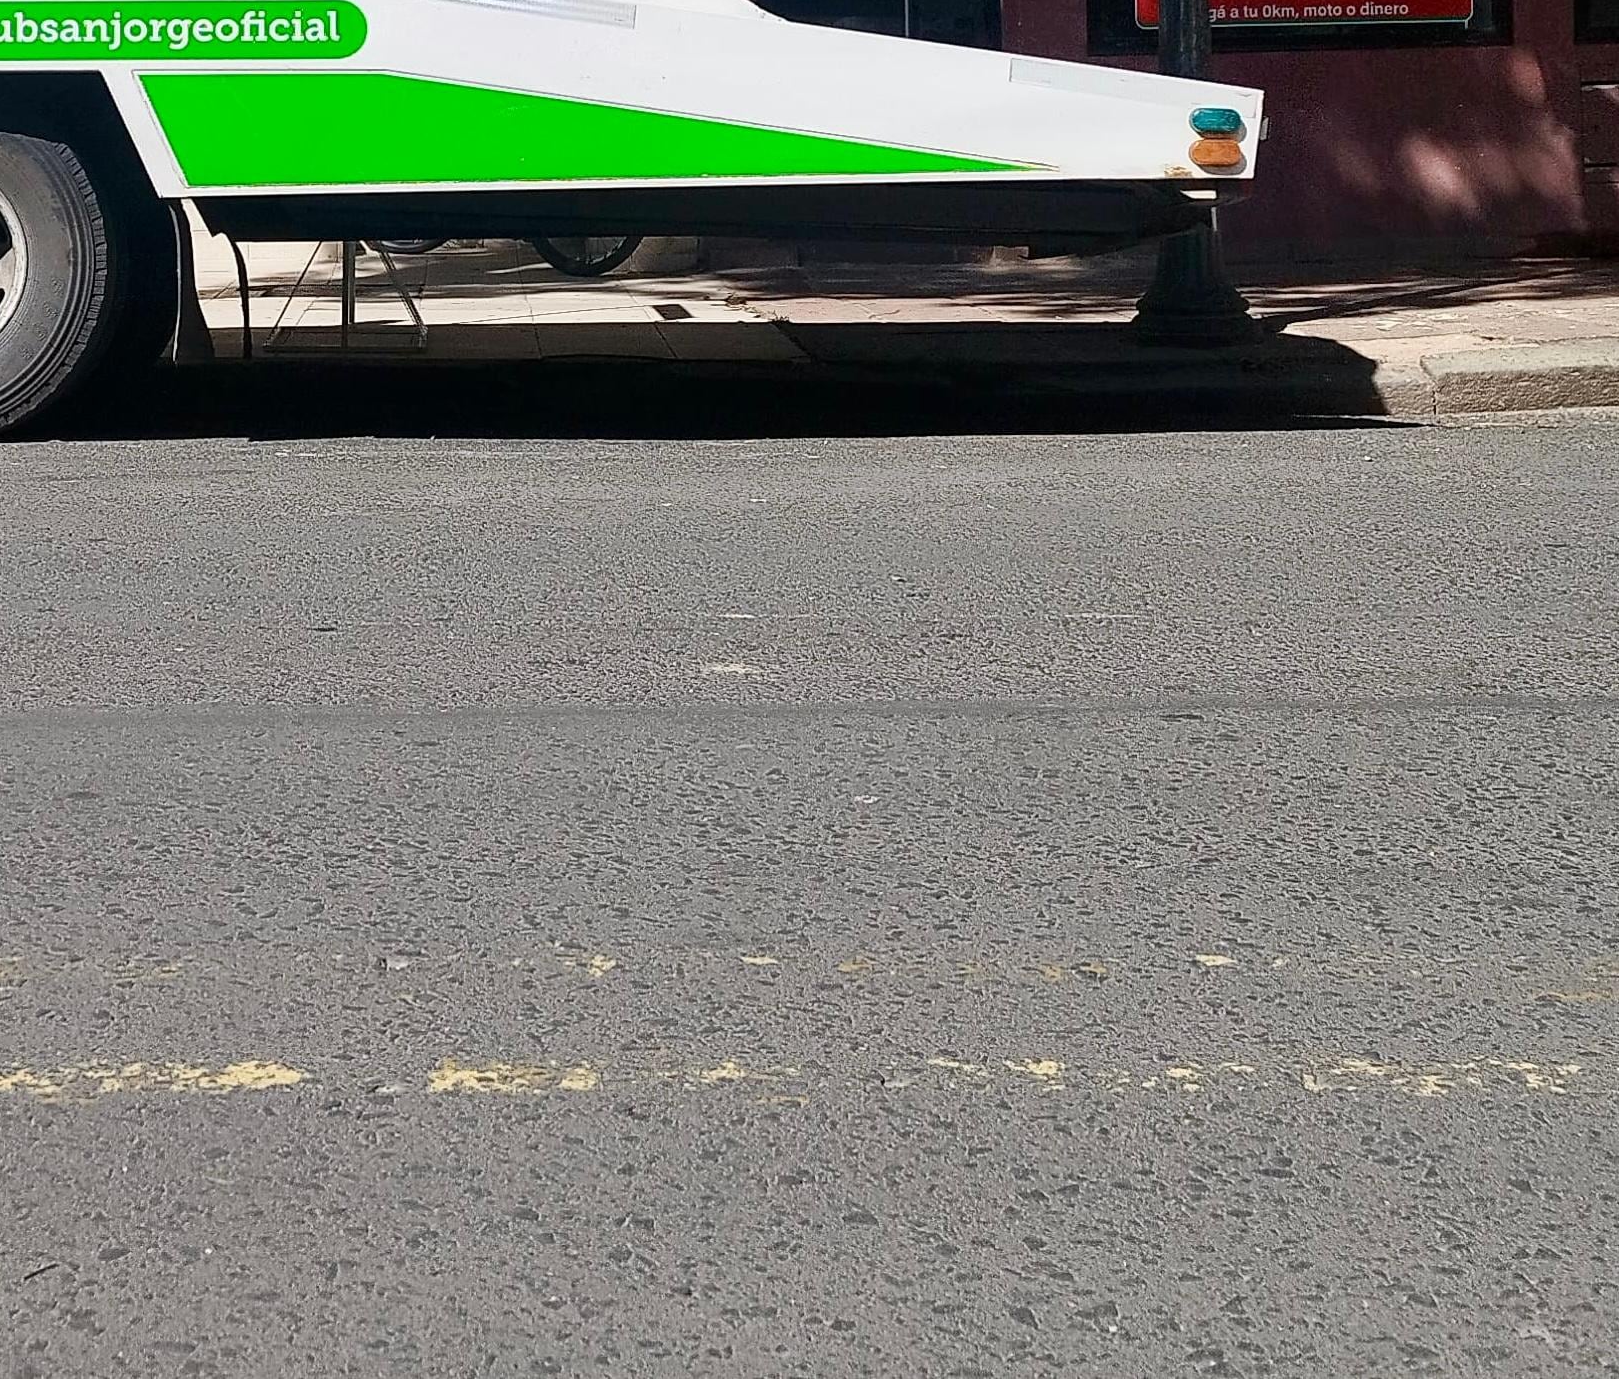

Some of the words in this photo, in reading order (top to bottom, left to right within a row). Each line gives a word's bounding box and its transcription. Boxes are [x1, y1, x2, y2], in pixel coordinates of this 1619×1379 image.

[1230, 8, 1239, 18] a
[1243, 5, 1258, 18] tu
[1262, 5, 1299, 19] 0km,
[1303, 3, 1341, 17] moto
[1346, 5, 1354, 16] o
[1359, 0, 1409, 16] dinero
